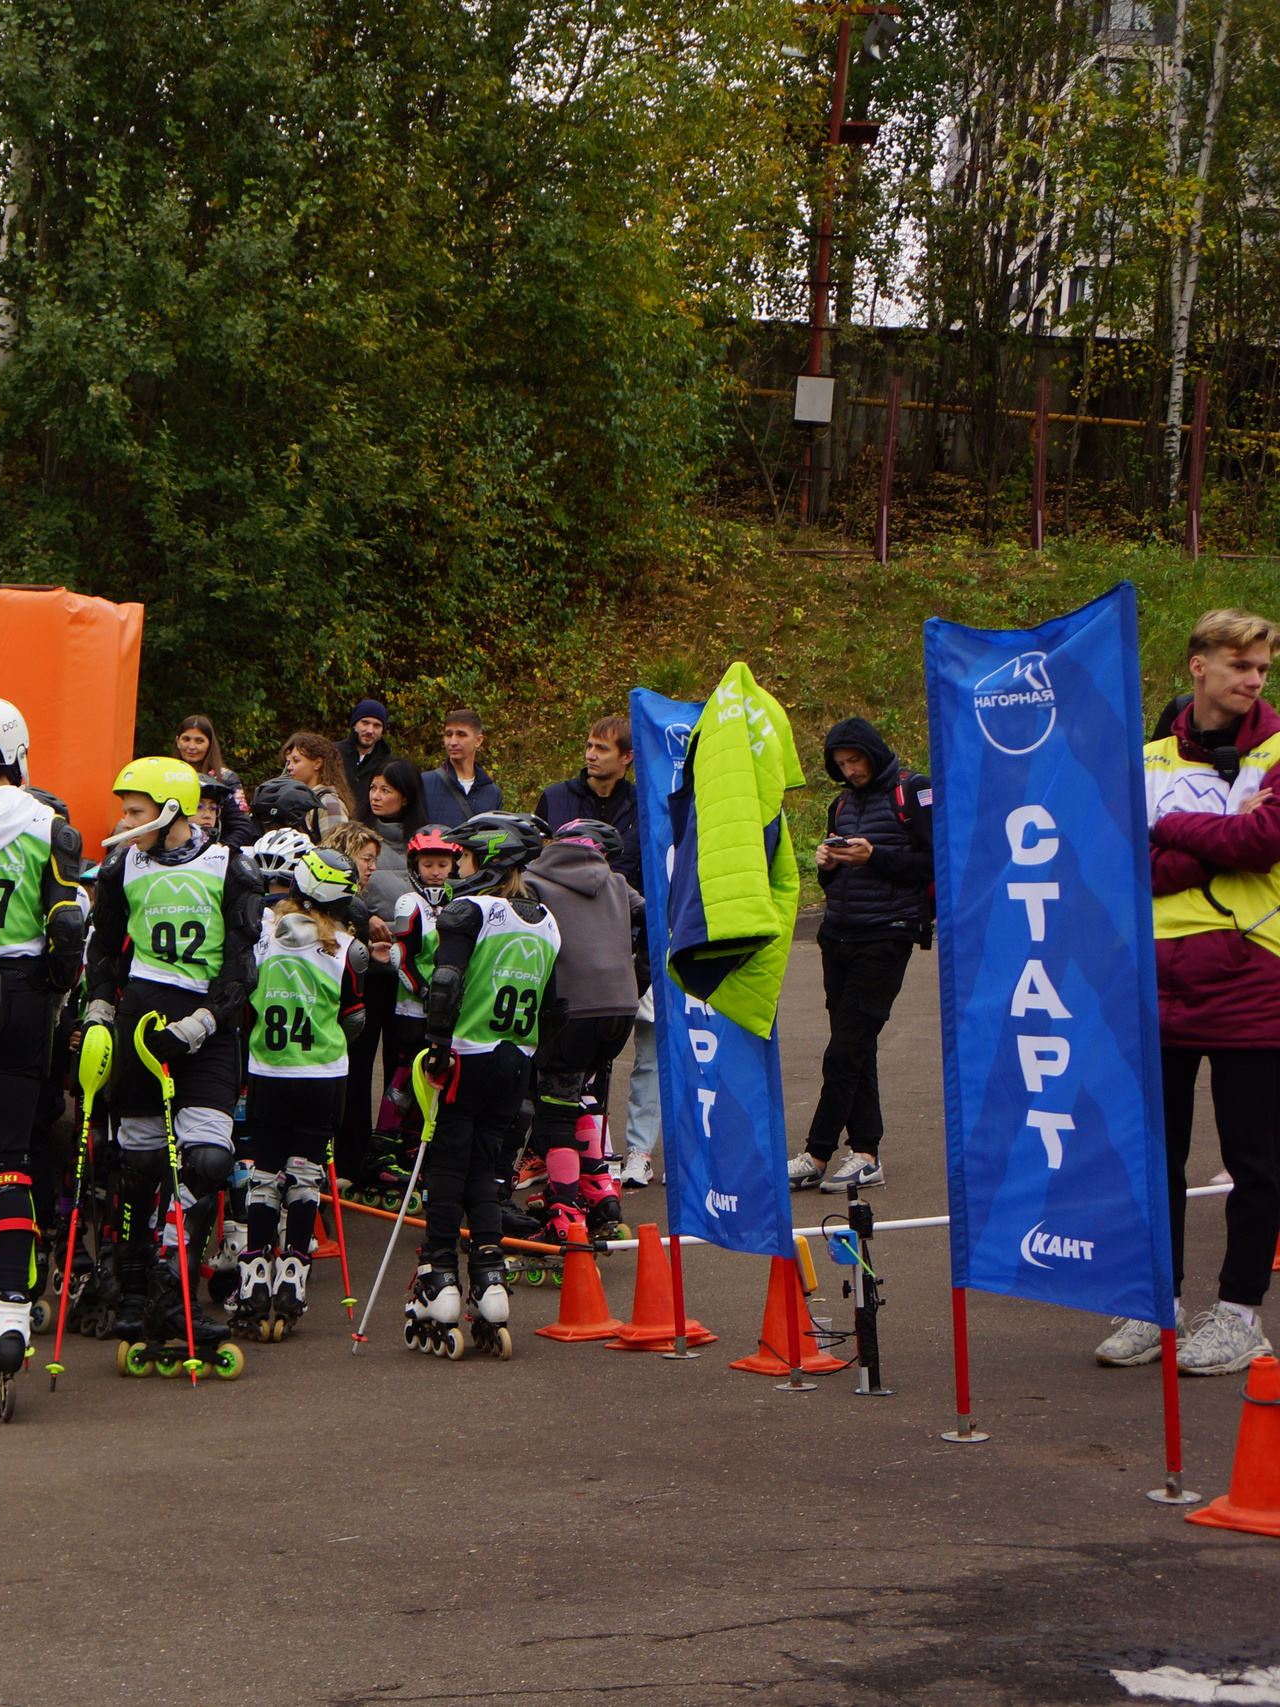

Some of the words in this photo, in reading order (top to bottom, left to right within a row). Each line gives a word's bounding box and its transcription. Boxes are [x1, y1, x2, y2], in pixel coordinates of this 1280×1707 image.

[716, 681, 776, 737] КНТ
[973, 689, 1055, 709] НАГОРНАЯ
[145, 905, 212, 916] НАГОРНАЯ
[152, 921, 209, 966] 92
[265, 991, 317, 1005] АГОРНАЯ
[1005, 805, 1075, 1169] СТАРТ
[264, 1004, 315, 1052] 84
[488, 985, 538, 1037] 93
[98, 1046, 111, 1076] LEKI
[122, 1202, 132, 1241] LEKI
[1031, 1232, 1094, 1260] КАНТ
